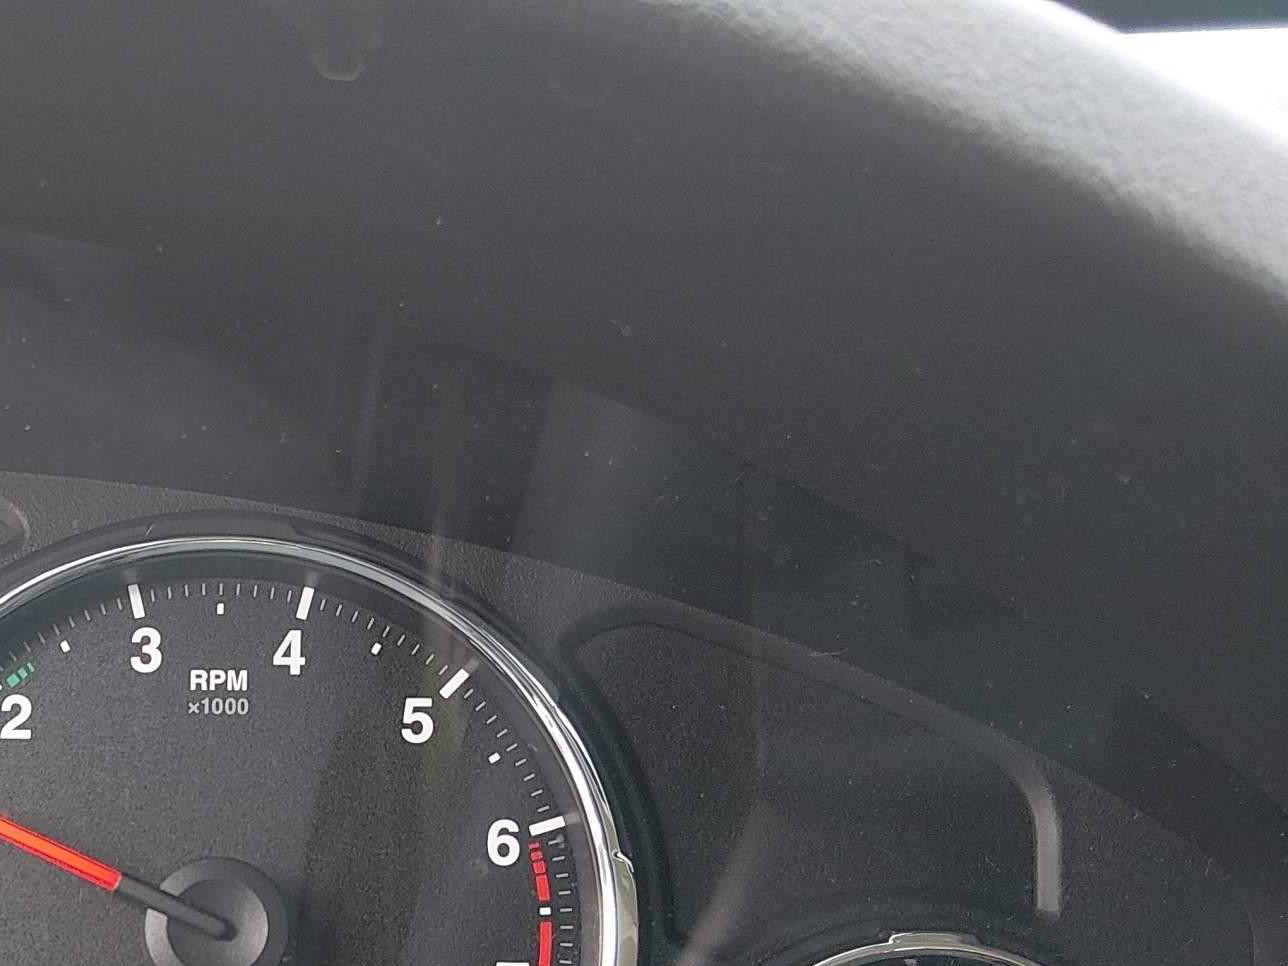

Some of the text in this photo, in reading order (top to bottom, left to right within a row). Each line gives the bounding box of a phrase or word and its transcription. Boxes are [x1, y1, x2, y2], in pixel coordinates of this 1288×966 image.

[131, 632, 162, 673] 3
[273, 633, 306, 675] 4
[190, 669, 248, 691] RPM
[0, 697, 32, 739] 2
[188, 697, 249, 715] x1000
[401, 699, 433, 743] 5
[487, 822, 520, 865] 6
